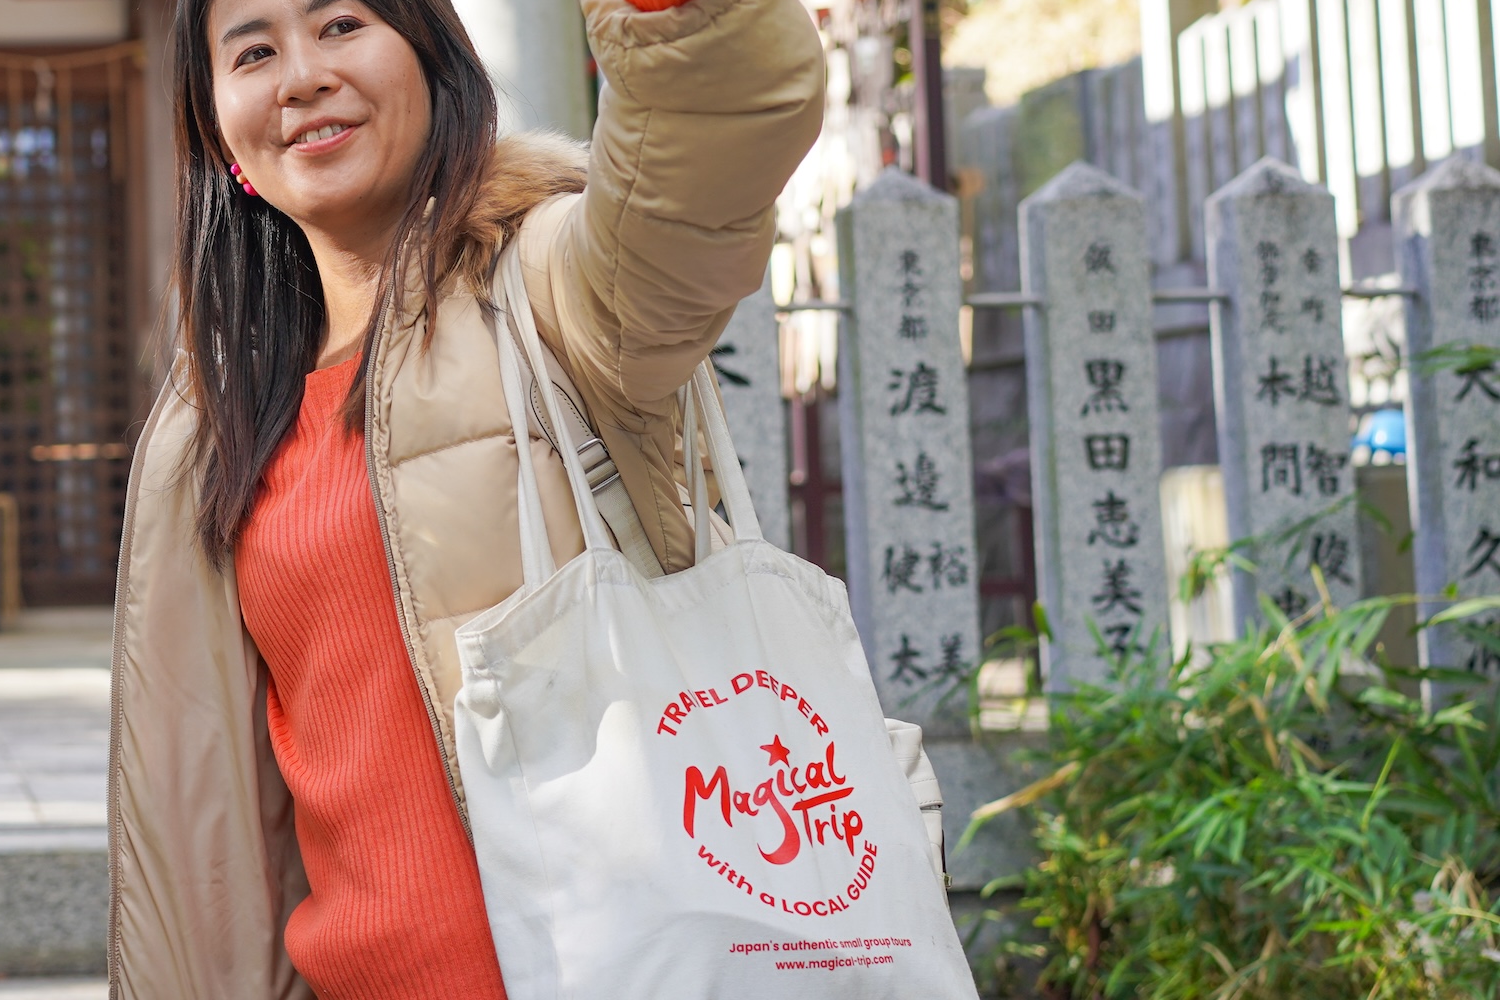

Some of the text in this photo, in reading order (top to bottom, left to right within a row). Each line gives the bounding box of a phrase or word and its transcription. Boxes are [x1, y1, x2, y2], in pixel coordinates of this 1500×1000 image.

[656, 669, 829, 738] TRAEL DEEPER
[683, 741, 846, 865] Magical
[792, 787, 864, 857] Trip
[698, 839, 878, 917] with a LOCAL GUIDE
[729, 936, 912, 956] Japan's authentic small group tours
[775, 953, 894, 972] www.magical-trip.com
